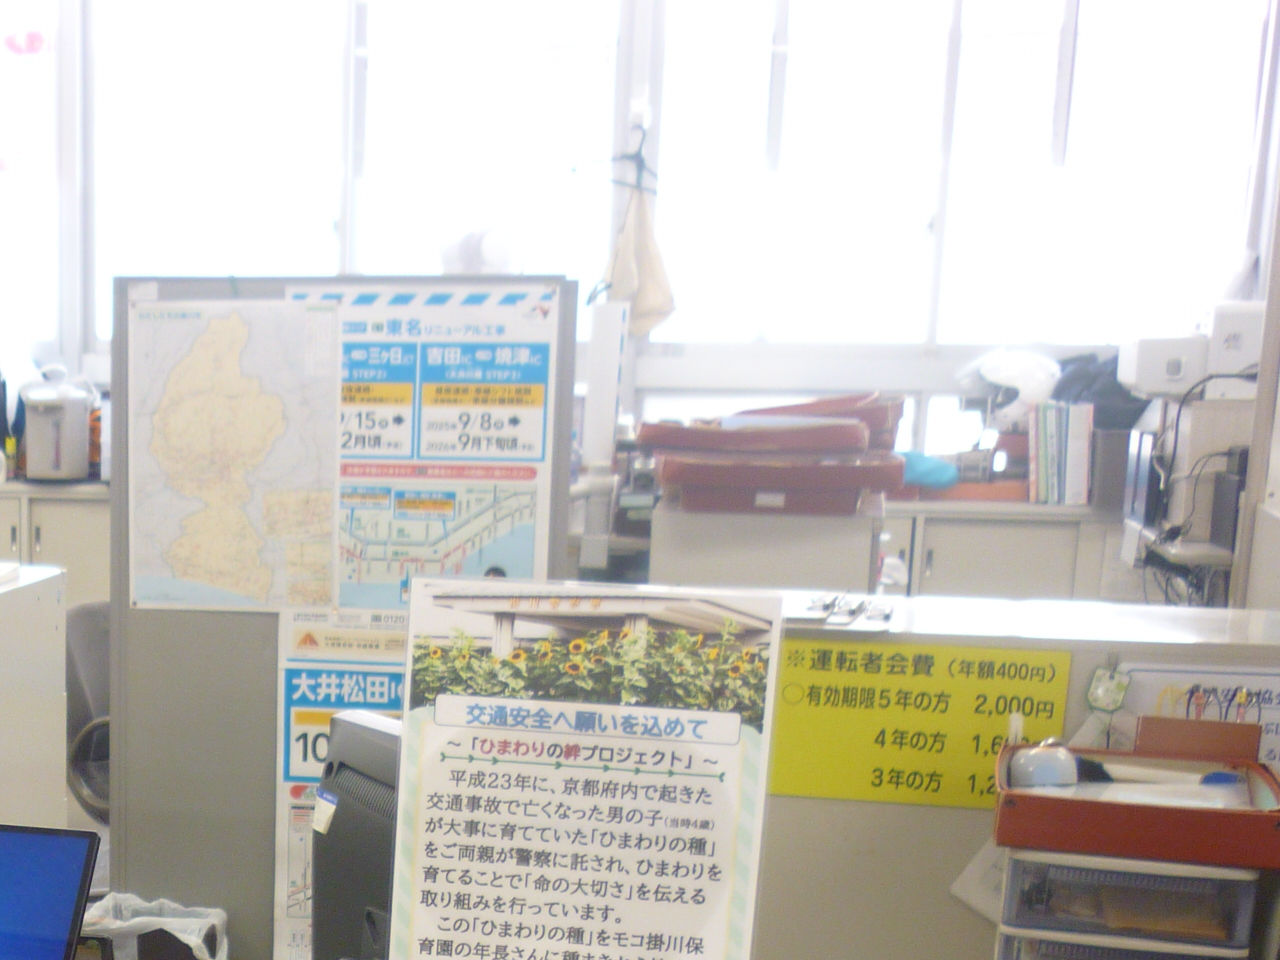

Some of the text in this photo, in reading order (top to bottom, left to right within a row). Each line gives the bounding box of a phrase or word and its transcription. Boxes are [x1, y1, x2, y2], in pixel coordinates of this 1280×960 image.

[466, 702, 709, 740] 交通安全へ願いを込めて
[449, 769, 713, 805] 平成23年に、京都府内で起きた
[424, 816, 716, 857] が大事に育てていた「ひまわりの種」
[423, 841, 722, 882] をご両親が警察に託され、ひまわりを
[422, 865, 706, 906] 育てることで「命の大切さ」を伝える
[420, 889, 622, 924] 取り組みを行っています。
[437, 916, 704, 955] この「ひまわりの種」をモコ掛川保
